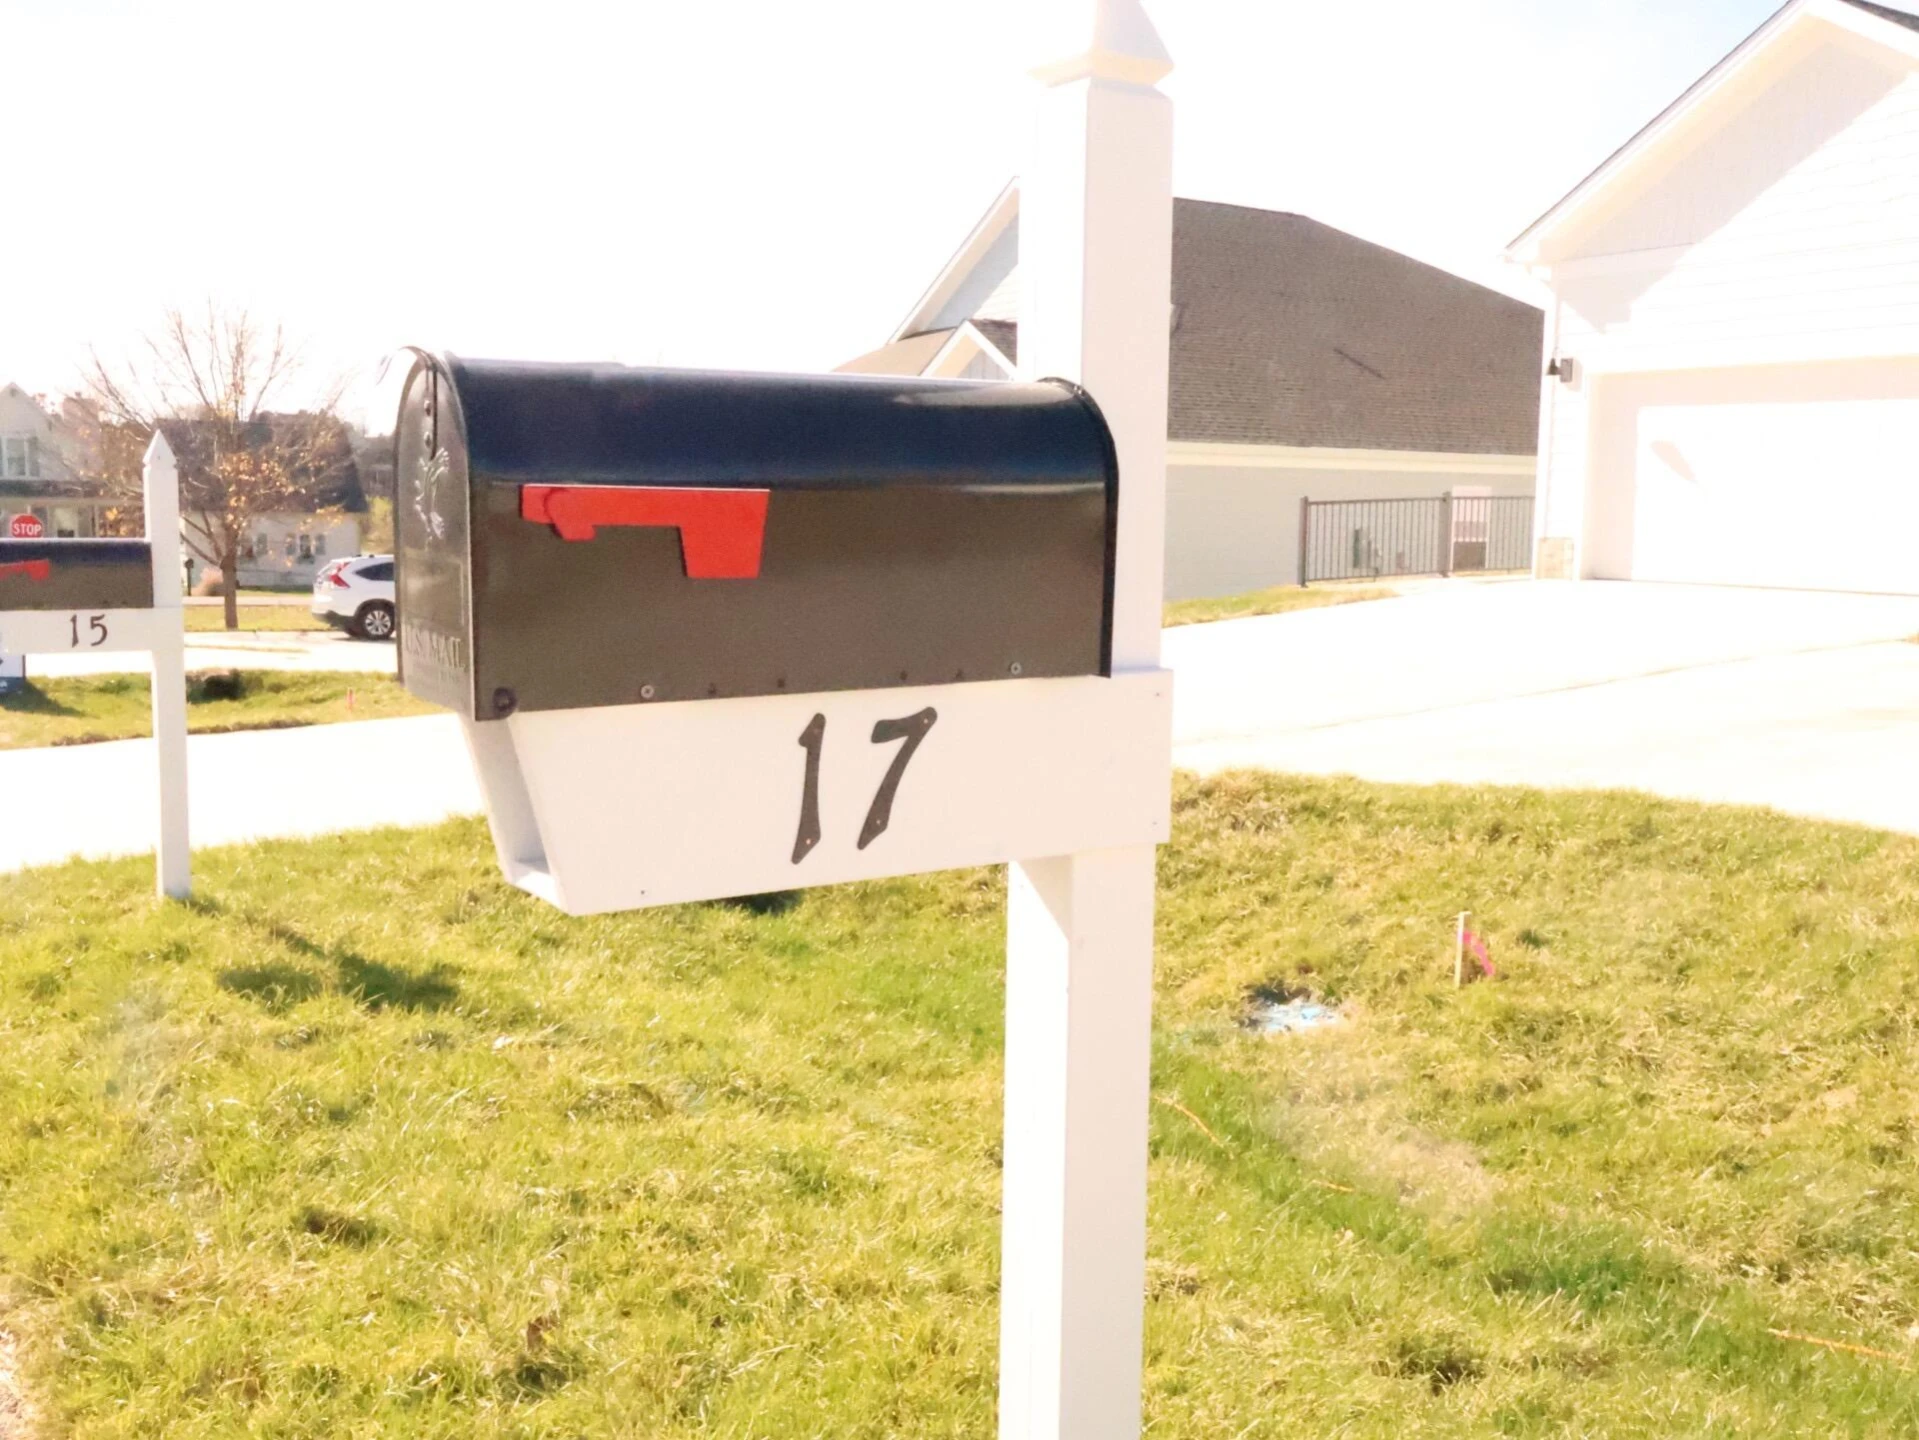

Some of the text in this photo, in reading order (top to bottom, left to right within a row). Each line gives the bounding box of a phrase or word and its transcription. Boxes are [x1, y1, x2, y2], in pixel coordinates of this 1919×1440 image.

[13, 523, 42, 535] STOP
[70, 614, 108, 647] 15
[430, 632, 466, 669] MAIL
[791, 706, 938, 864] 17
